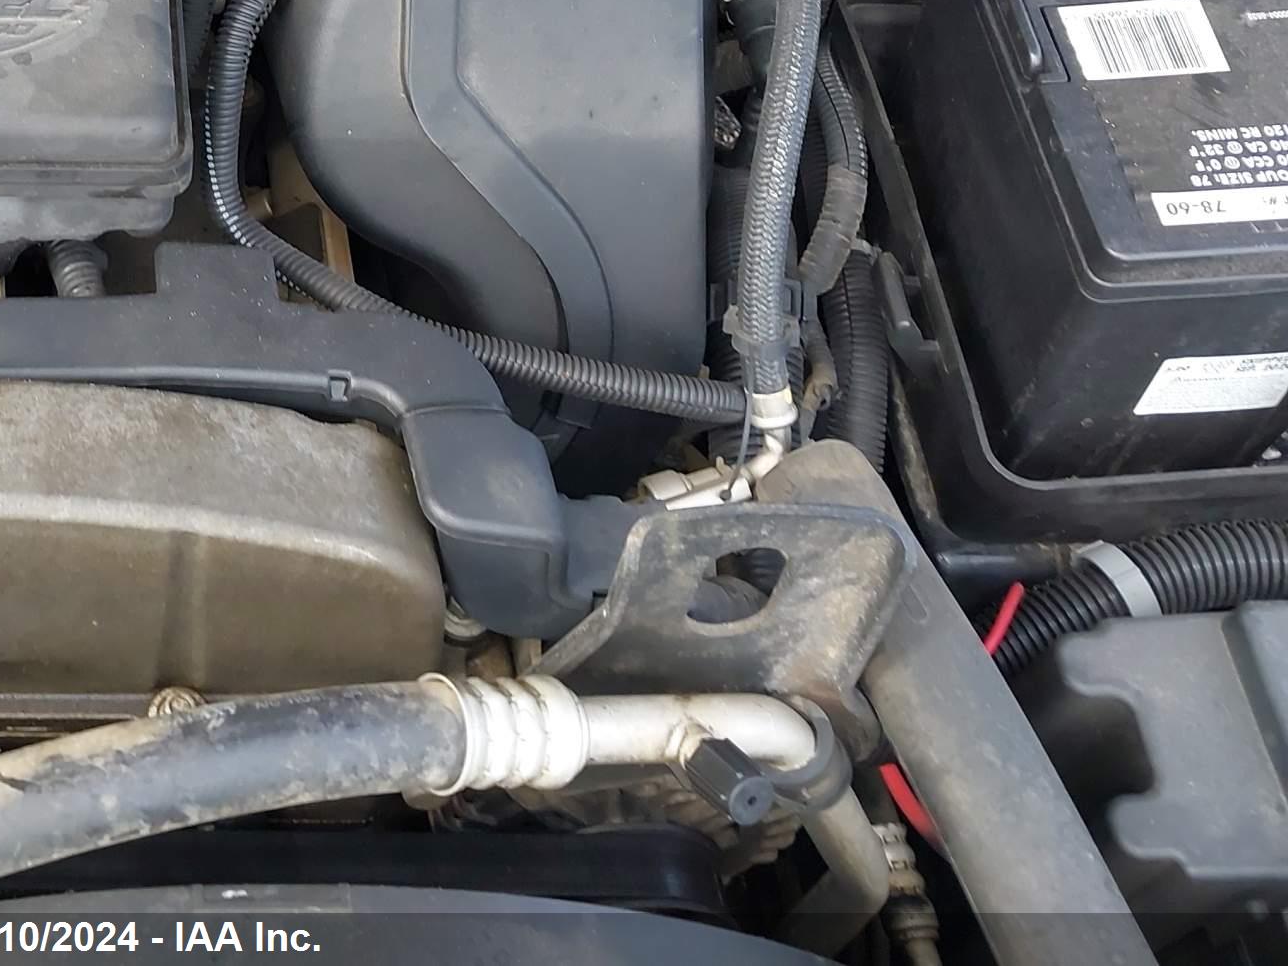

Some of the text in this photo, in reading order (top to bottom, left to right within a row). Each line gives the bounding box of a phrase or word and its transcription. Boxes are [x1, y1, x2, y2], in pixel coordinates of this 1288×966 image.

[1192, 129, 1238, 142] MINS.
[1239, 125, 1262, 139] RC
[1226, 141, 1244, 154] @
[1244, 140, 1268, 153] CA
[1224, 156, 1240, 170] @
[1241, 155, 1274, 169] CCA
[1190, 174, 1213, 187] 78
[1213, 172, 1254, 185] SIZE:
[1166, 200, 1226, 216] 78-60
